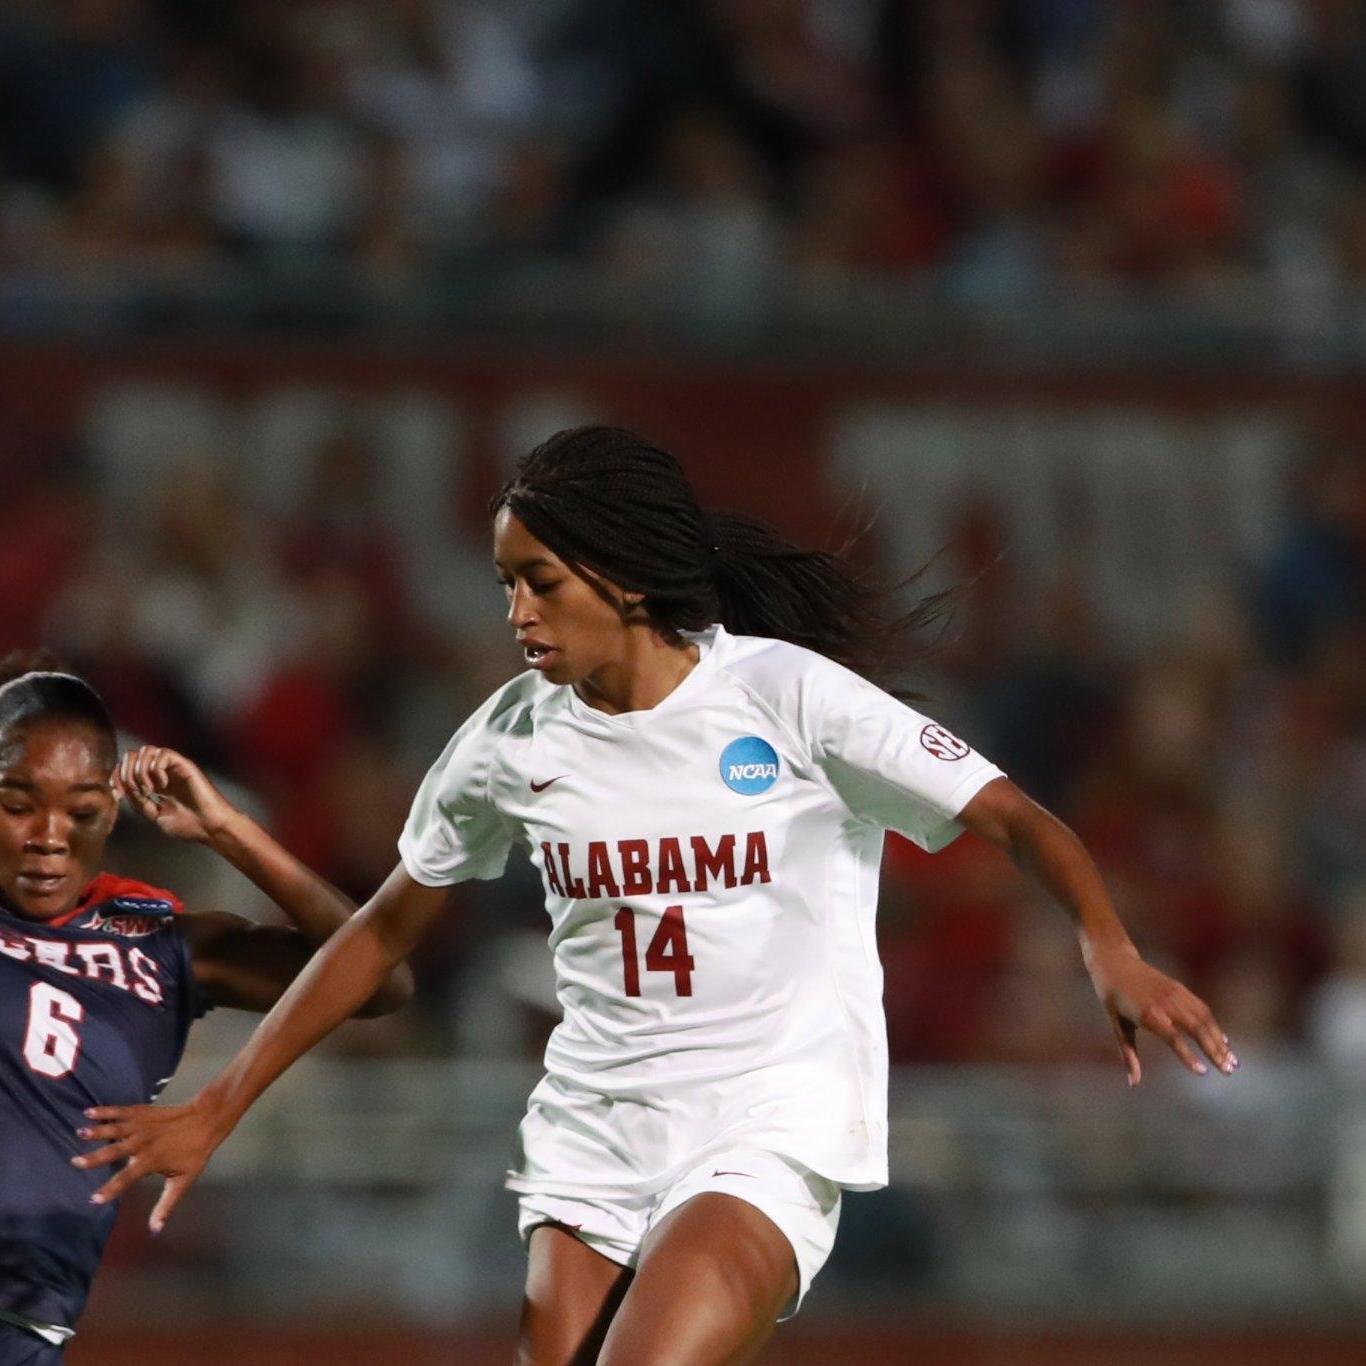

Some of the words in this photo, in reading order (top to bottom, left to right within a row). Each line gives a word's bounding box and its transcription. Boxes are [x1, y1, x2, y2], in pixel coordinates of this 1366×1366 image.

[729, 764, 777, 781] NCAA
[541, 831, 771, 899] ALABAMA
[614, 905, 695, 998] 14
[23, 980, 85, 1079] 6
